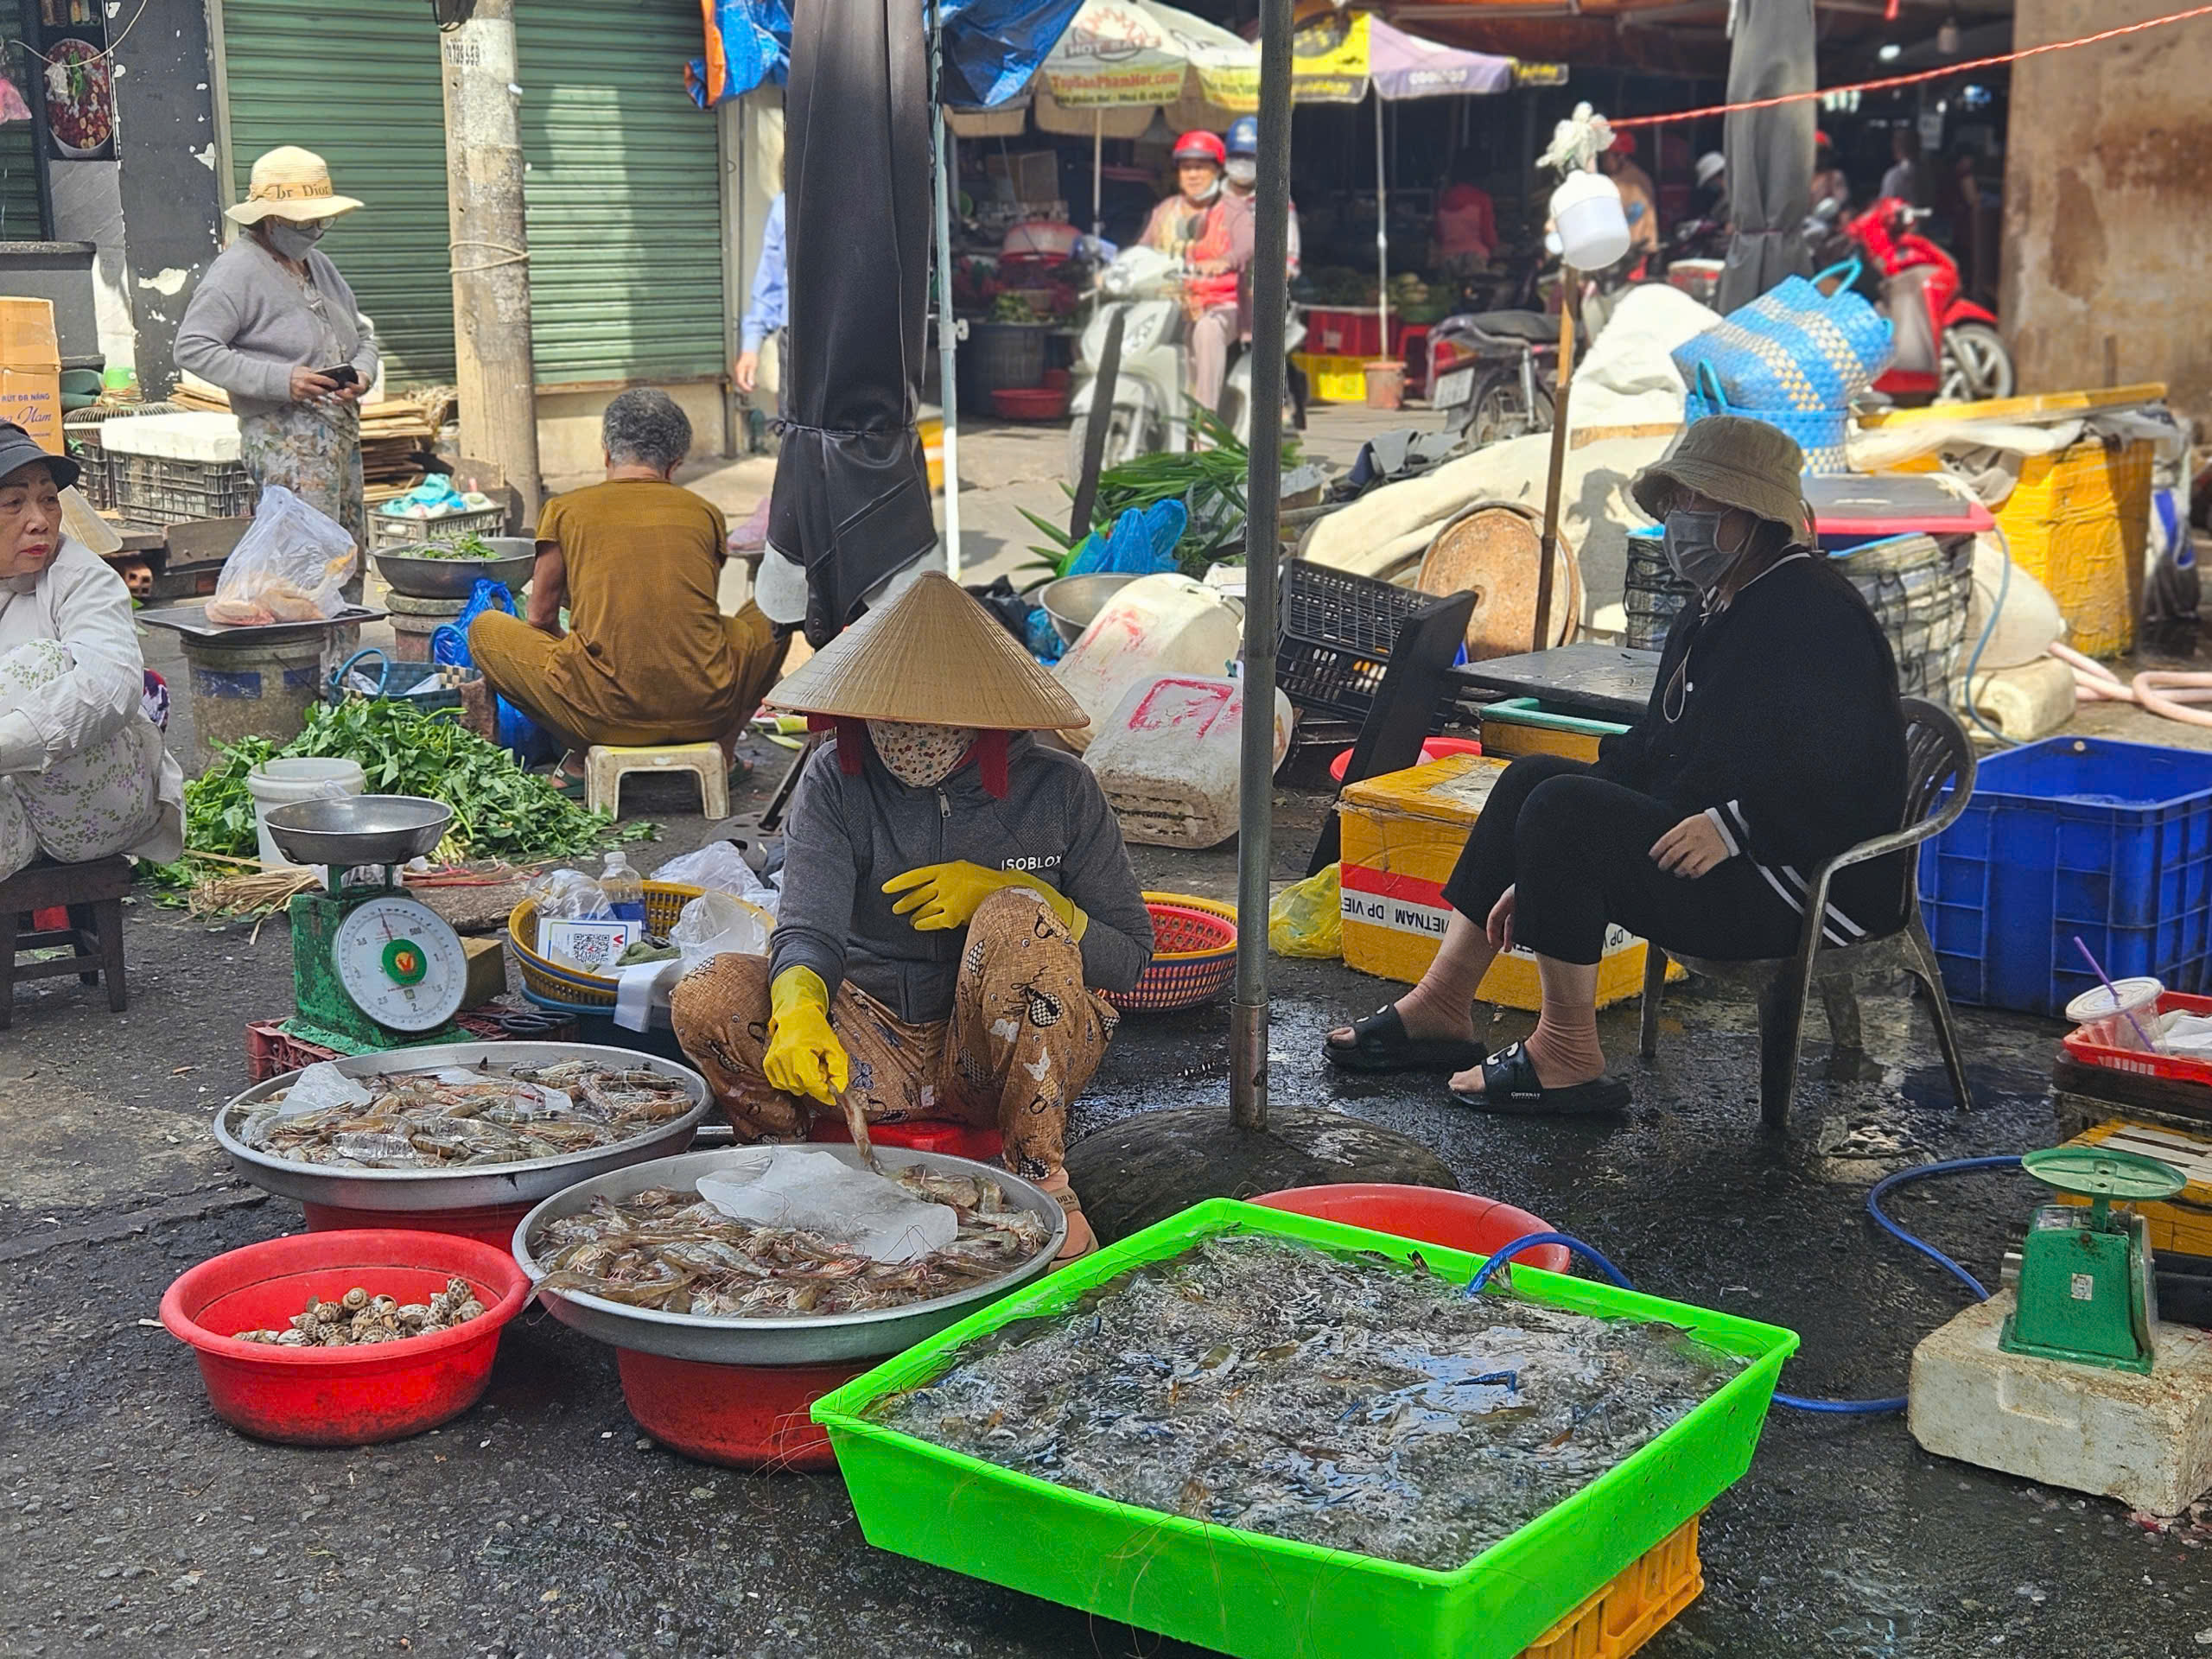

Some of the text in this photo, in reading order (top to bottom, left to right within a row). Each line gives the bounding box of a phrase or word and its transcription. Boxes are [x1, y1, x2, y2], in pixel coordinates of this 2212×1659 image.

[302, 183, 329, 197] Dior
[1001, 853, 1063, 871] ISOBLOX
[1340, 897, 1363, 916] VIE
[1367, 905, 1384, 920] DP
